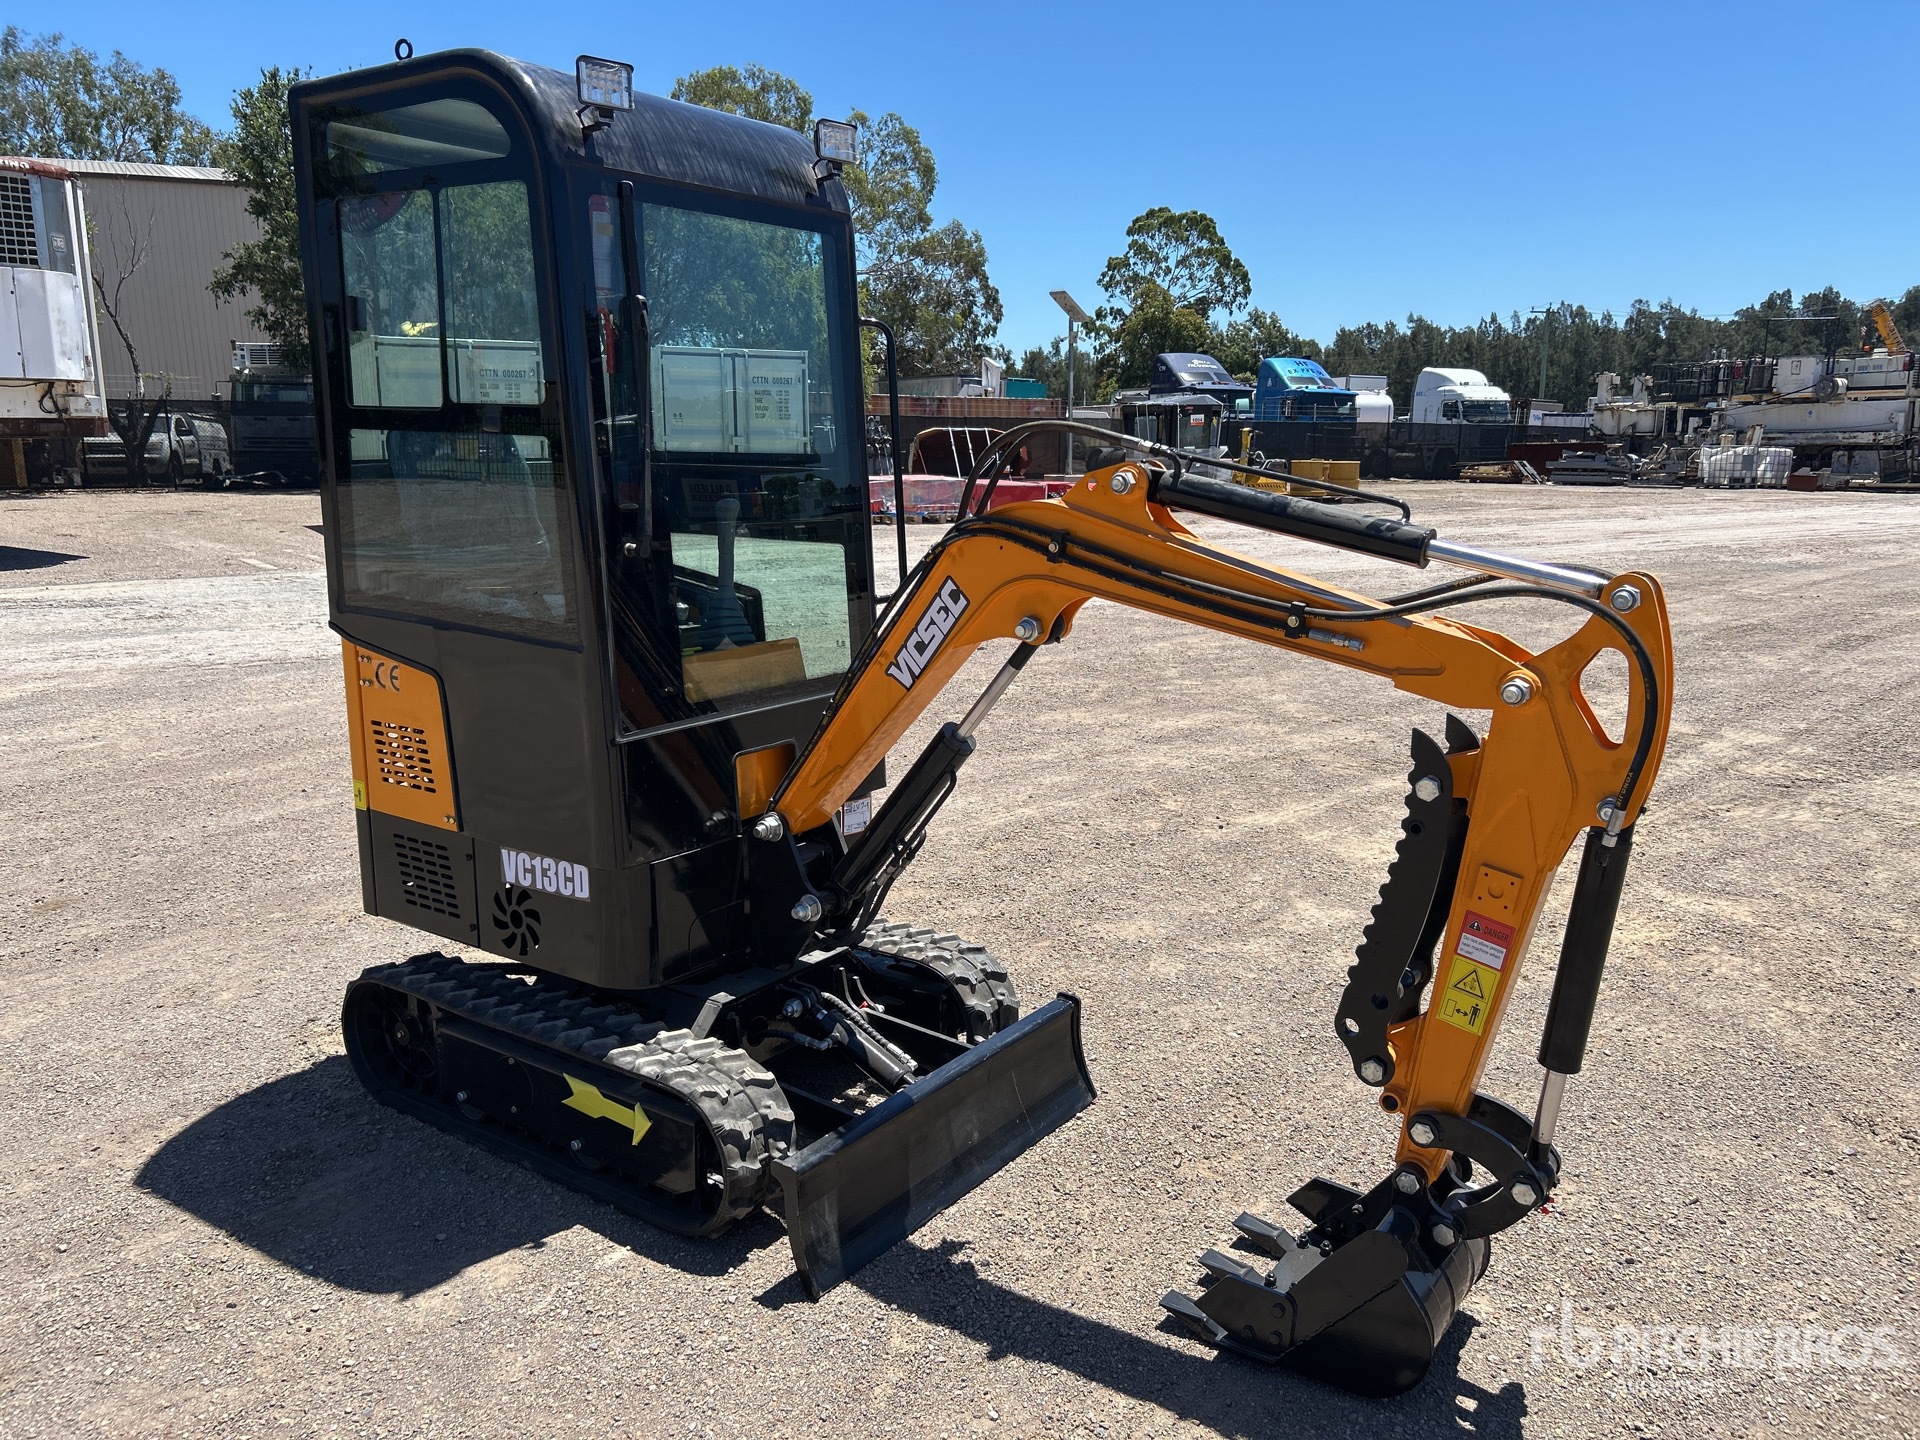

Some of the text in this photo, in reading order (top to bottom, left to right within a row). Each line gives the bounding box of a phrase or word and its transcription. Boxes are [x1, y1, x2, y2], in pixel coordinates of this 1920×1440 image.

[479, 368, 526, 379] CTTN 000267
[751, 376, 769, 385] CTTN
[886, 578, 969, 690] VICSEC
[501, 848, 590, 899] VC13CD
[1484, 926, 1509, 943] DANGER
